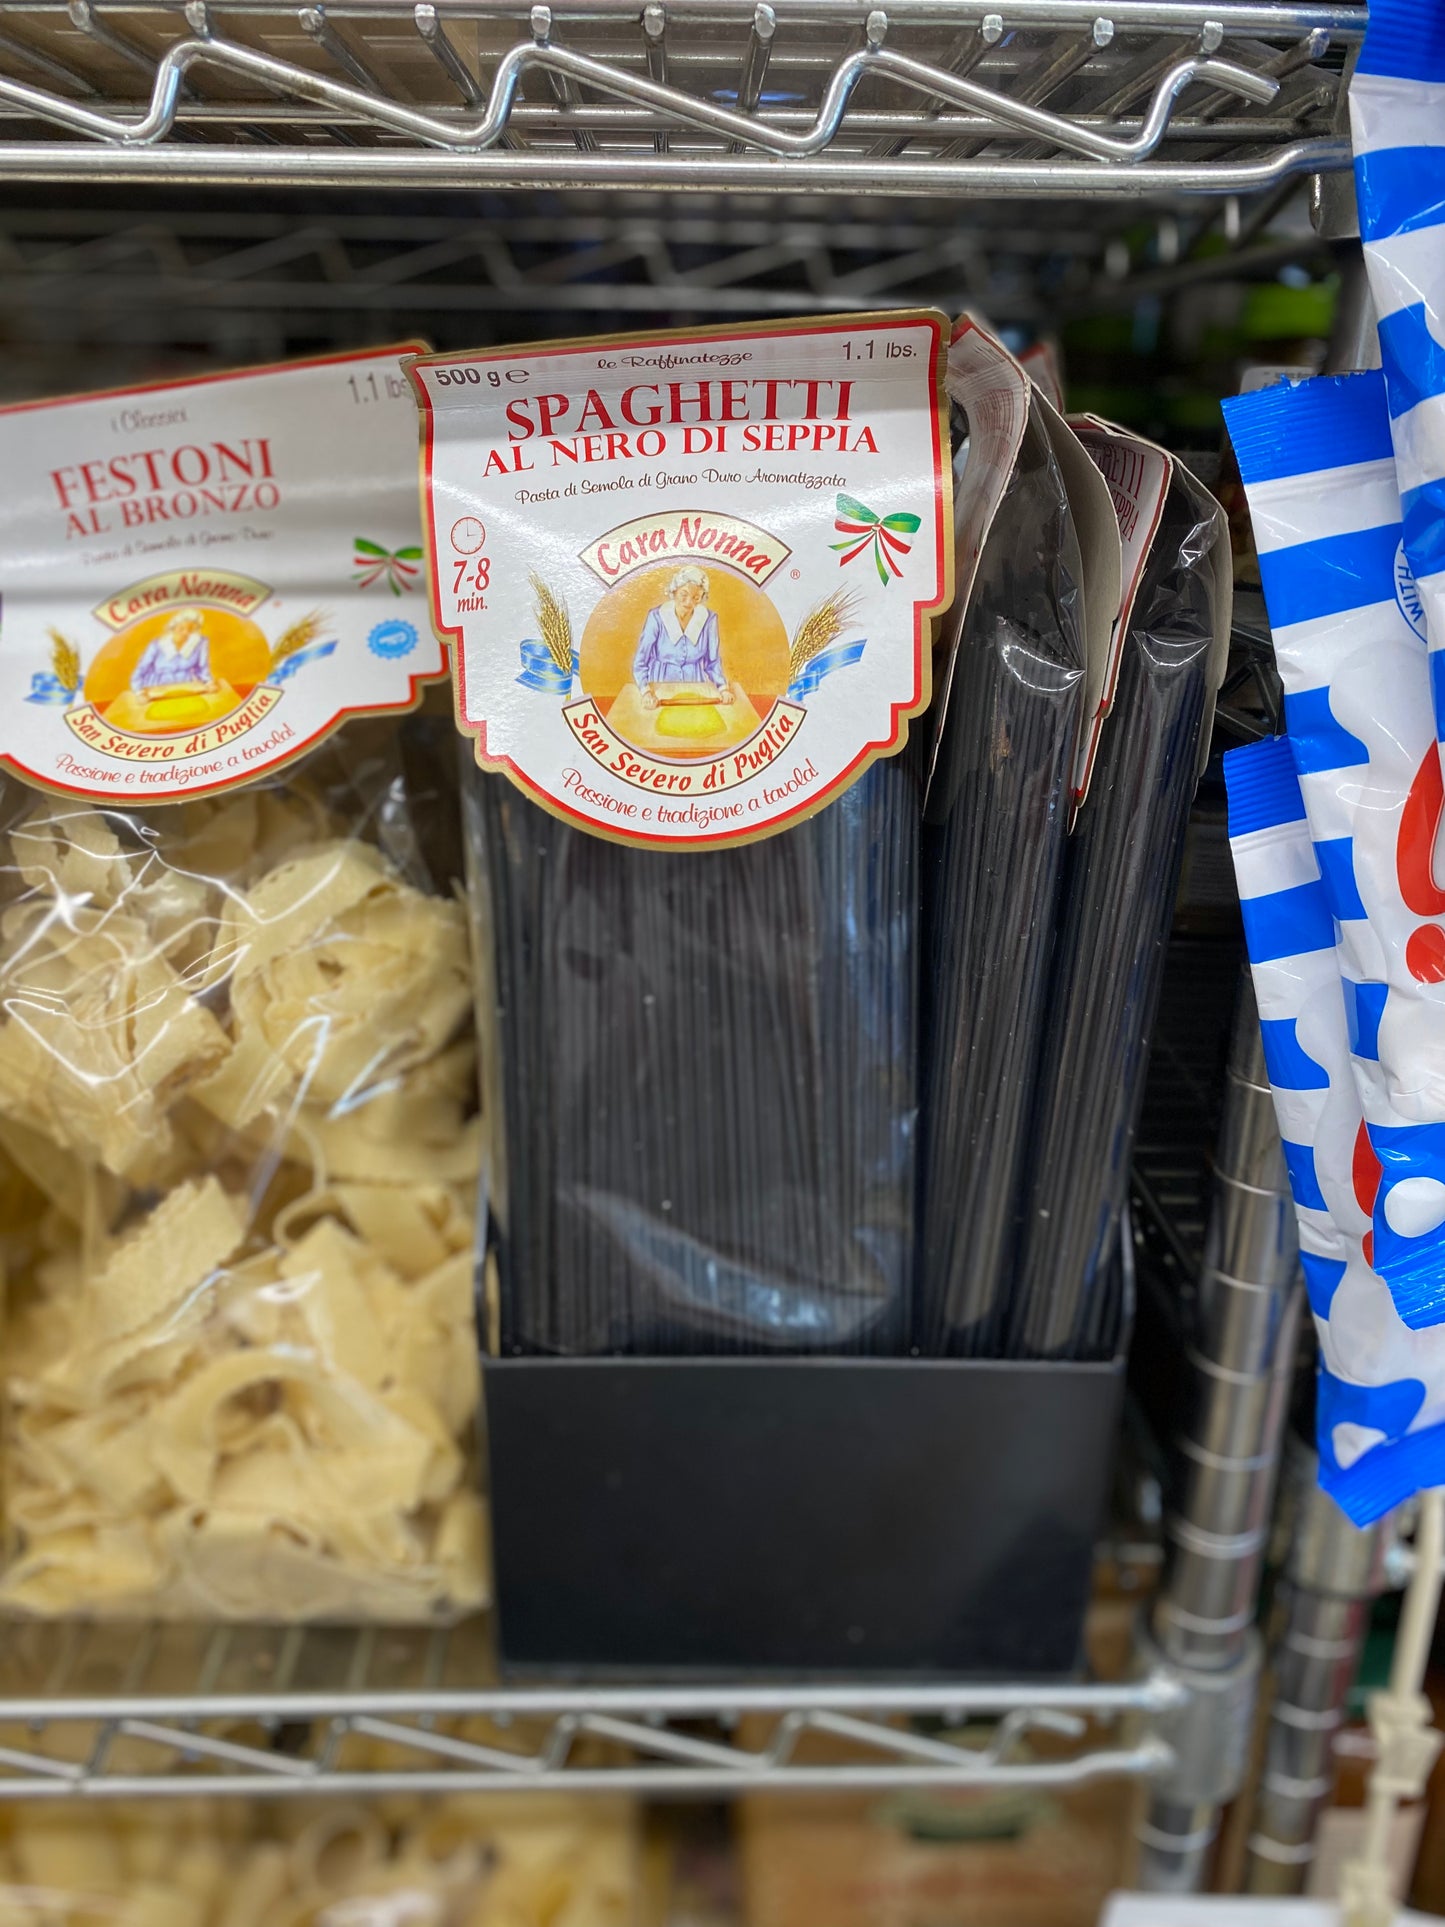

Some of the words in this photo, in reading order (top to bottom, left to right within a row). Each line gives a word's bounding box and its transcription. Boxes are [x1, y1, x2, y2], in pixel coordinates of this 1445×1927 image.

[434, 367, 481, 386] 500
[487, 370, 501, 387] g
[622, 351, 753, 371] Raffinatezze
[842, 339, 874, 360] 1.1
[886, 342, 917, 358] lbs.
[348, 372, 379, 404] 1.1
[504, 379, 857, 442] SPAGHETTI
[49, 438, 277, 510] FESTONI
[482, 445, 534, 477] AL
[549, 429, 667, 467] NERO
[682, 425, 727, 455] DI
[742, 424, 880, 454] SEPPIA
[65, 507, 111, 540] AL
[122, 480, 280, 528] BRONZO
[514, 488, 560, 504] Pasta
[564, 483, 578, 497] di
[581, 475, 634, 495] Semola
[638, 472, 653, 487] di
[655, 471, 698, 489] Grano
[702, 468, 742, 484] Duro
[745, 468, 847, 490] Aromatizzata
[597, 528, 668, 576] Cara
[673, 517, 772, 575] Nonna
[108, 585, 170, 623] Cara
[174, 575, 257, 608] Nonna
[453, 557, 491, 594] 7-8
[457, 592, 488, 612] min.
[1397, 565, 1424, 623] WITH
[56, 753, 122, 784] Passione
[125, 773, 135, 784] e
[139, 761, 224, 785] tradizione
[227, 756, 239, 767] a
[242, 722, 296, 762] tavola!
[72, 712, 102, 741] San
[101, 735, 175, 759] Severo
[185, 733, 207, 755] di
[215, 694, 273, 743] Puglia
[573, 713, 609, 756] San
[610, 751, 692, 792] Severo
[702, 765, 726, 790] di
[736, 714, 794, 779] Puglia
[561, 767, 637, 818] Passione
[641, 810, 652, 821] e
[657, 802, 744, 829] tradizione
[748, 797, 760, 812] a
[762, 757, 820, 805] tavola!
